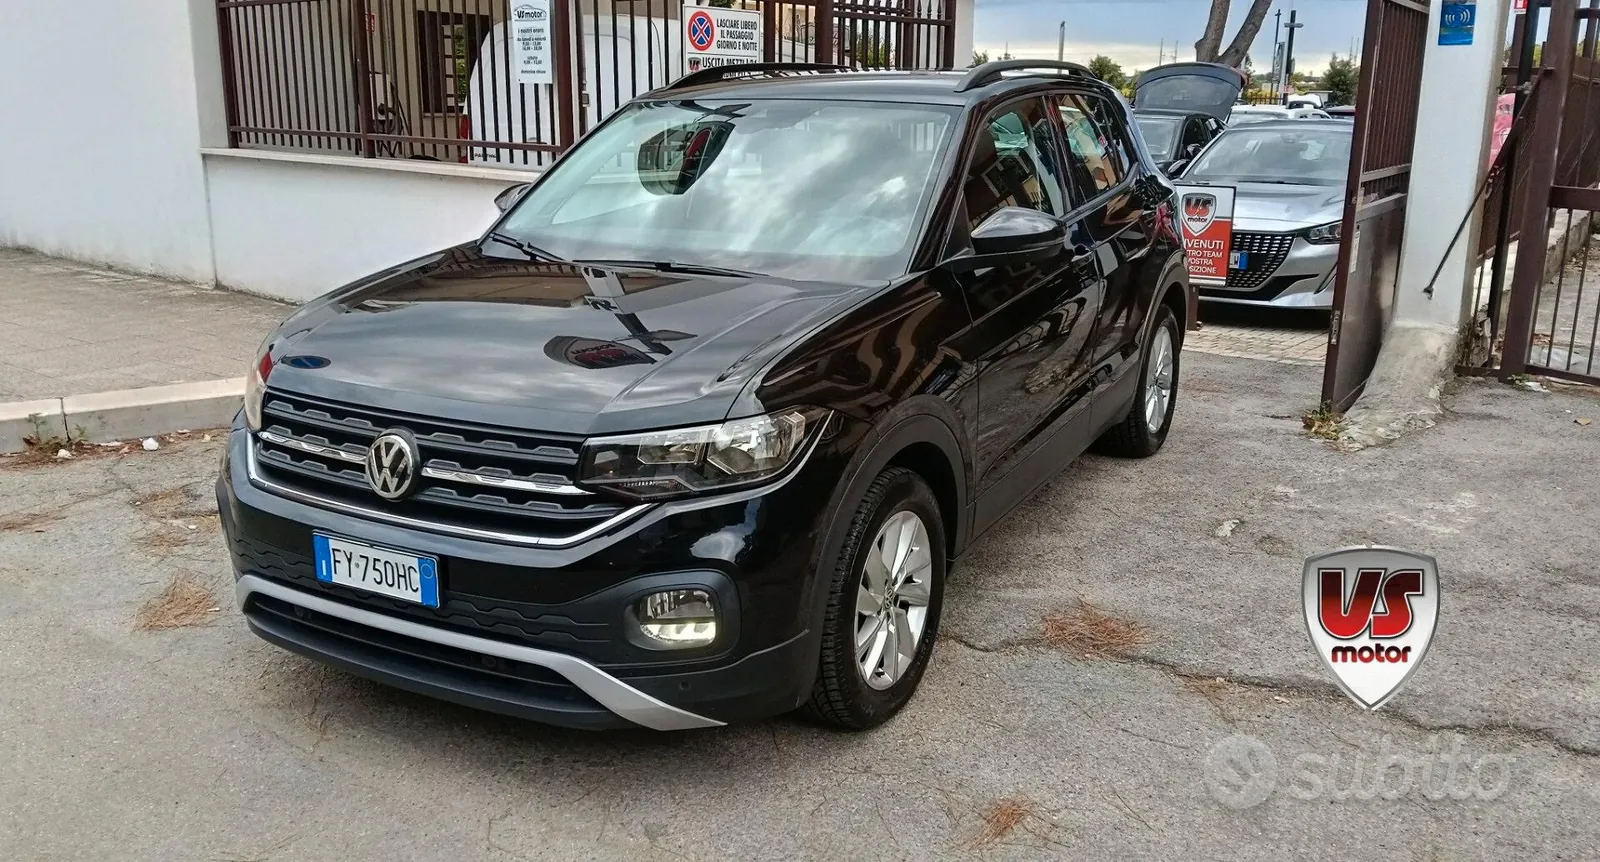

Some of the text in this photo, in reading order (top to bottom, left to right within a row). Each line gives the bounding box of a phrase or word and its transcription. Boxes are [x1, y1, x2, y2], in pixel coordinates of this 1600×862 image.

[717, 18, 758, 31] LASCIARE LIBERO
[720, 30, 754, 41] IL PASSAGGIO
[716, 40, 758, 51] GIORNO E NOTTE
[702, 57, 725, 68] USCITA
[1203, 250, 1223, 258] TEAM
